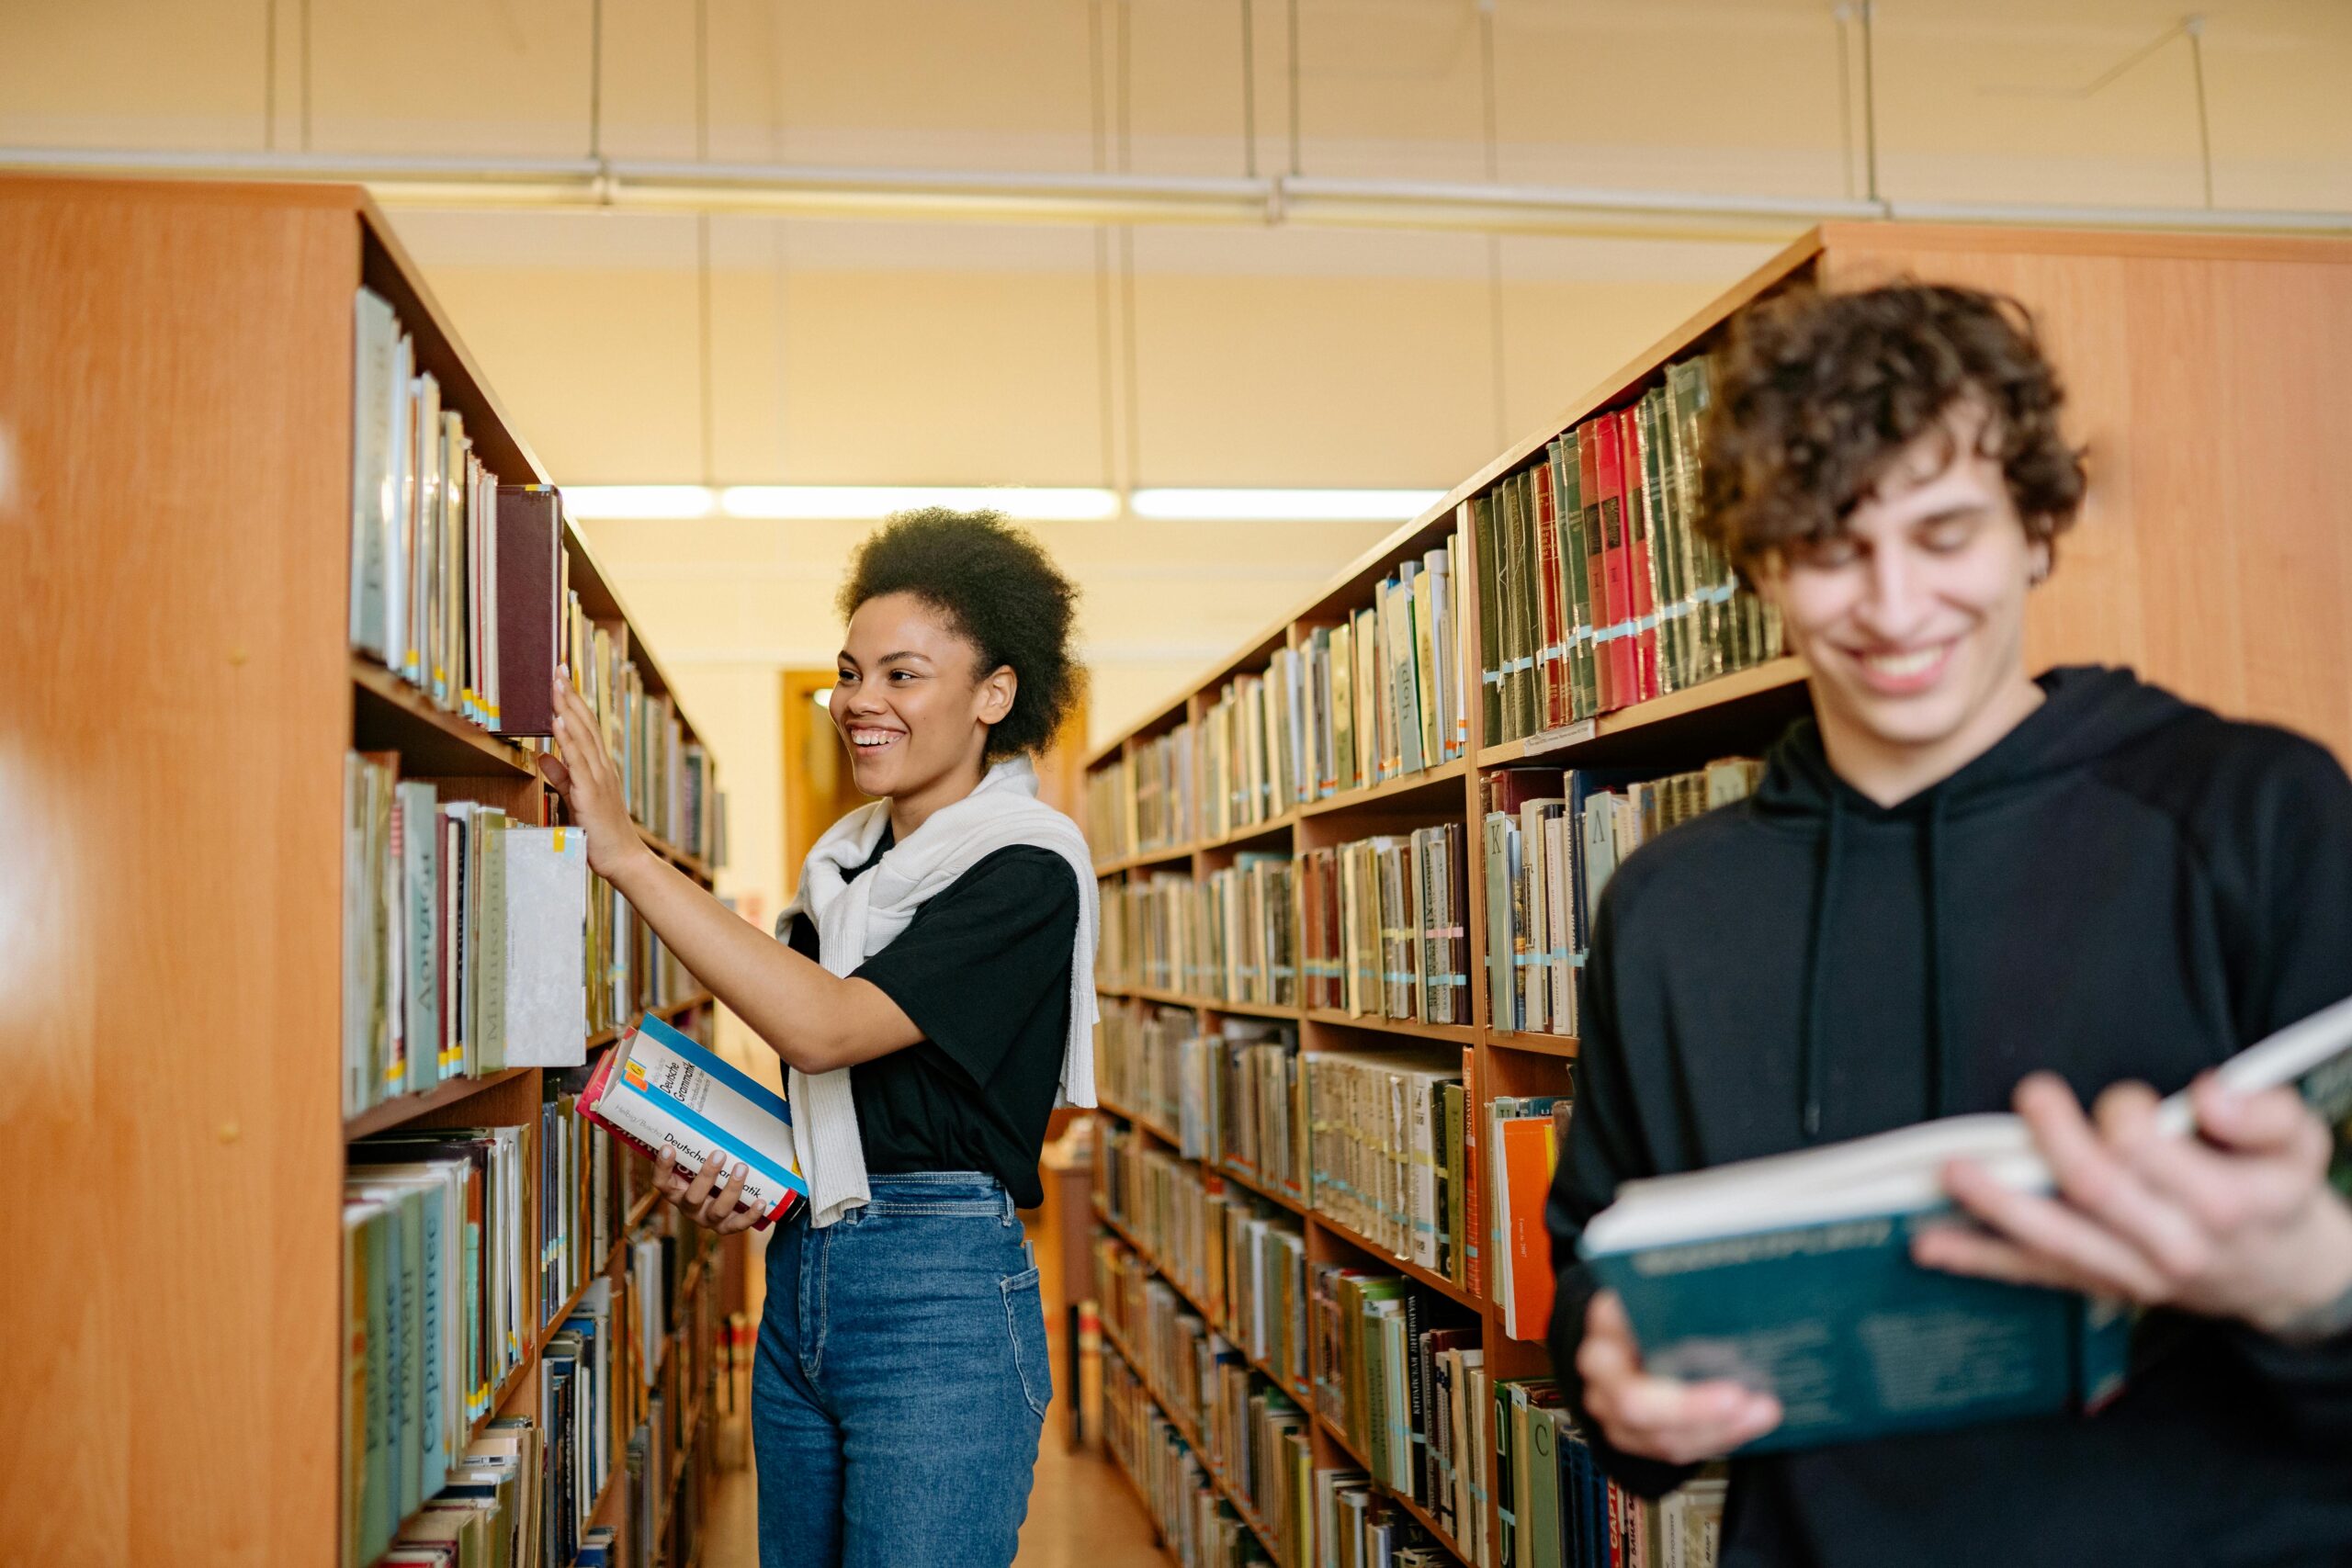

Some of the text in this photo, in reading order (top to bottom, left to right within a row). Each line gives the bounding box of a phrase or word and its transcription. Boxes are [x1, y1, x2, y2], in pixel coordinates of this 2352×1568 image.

[659, 1062, 680, 1094] Deutsche
[673, 1060, 695, 1102] Grammatik
[663, 1132, 707, 1165] Deutsche
[423, 1216, 439, 1454] Сервантес
[1408, 1294, 1419, 1354] ЛИТЕРАТУРА
